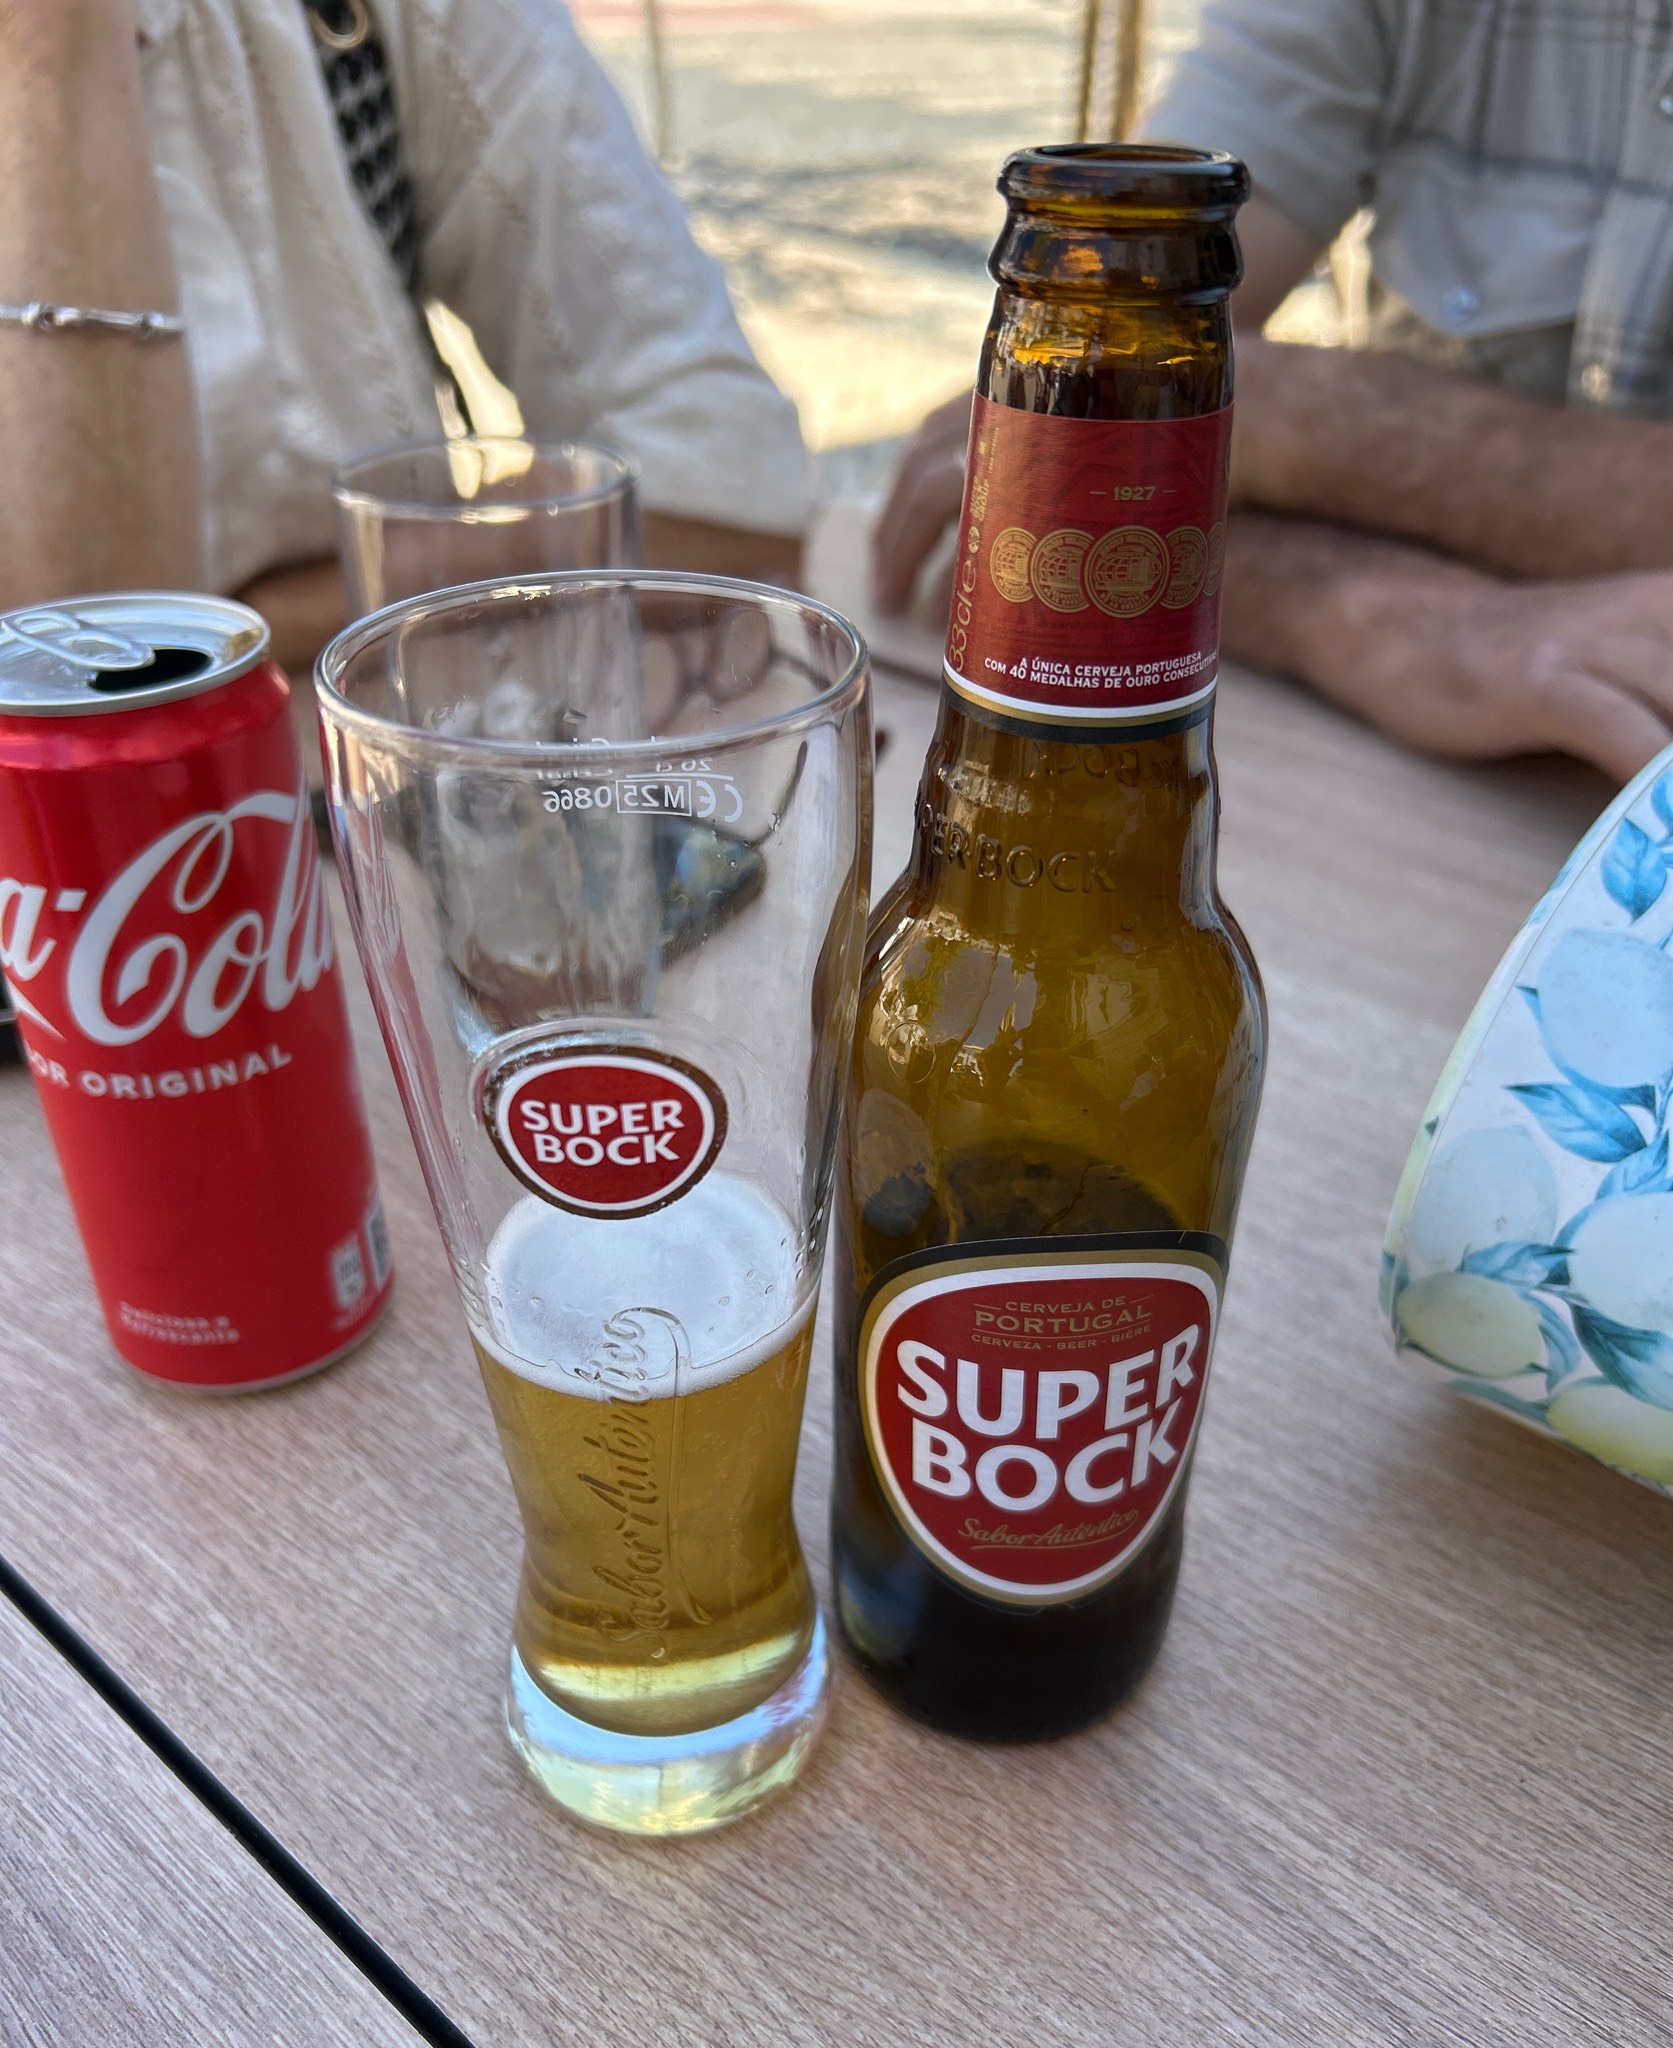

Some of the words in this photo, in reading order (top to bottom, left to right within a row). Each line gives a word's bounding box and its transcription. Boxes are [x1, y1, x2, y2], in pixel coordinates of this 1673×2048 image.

[977, 479, 989, 520] GROUP
[1113, 486, 1156, 501] 1927
[984, 657, 1007, 675] COM
[1009, 665, 1027, 680] 40
[1030, 671, 1100, 689] MEDALHAS
[1104, 677, 1122, 689] DE
[1126, 674, 1160, 688] OURO
[1019, 657, 1028, 668] A
[1031, 656, 1071, 676] ÚNICA
[1075, 664, 1131, 678] CERVEJA
[1135, 651, 1202, 677] PORTUGUESA
[975, 833, 1117, 893] BOCK
[78, 1042, 293, 1100] ORIGINAL
[520, 1100, 685, 1136] SUPER
[533, 1131, 681, 1167] BOCK
[975, 1304, 1152, 1334] PORTUGAL
[1005, 1301, 1095, 1314] CERVEJA
[1101, 1296, 1126, 1309] DE
[971, 1334, 1041, 1350] CERVEZA
[1056, 1339, 1097, 1350] BEER
[1111, 1323, 1152, 1344] BIÈRE
[896, 1324, 1199, 1439] SUPER
[912, 1397, 1182, 1512] BOCK
[958, 1517, 1033, 1545] Sabor
[592, 1530, 669, 1659] Sabor
